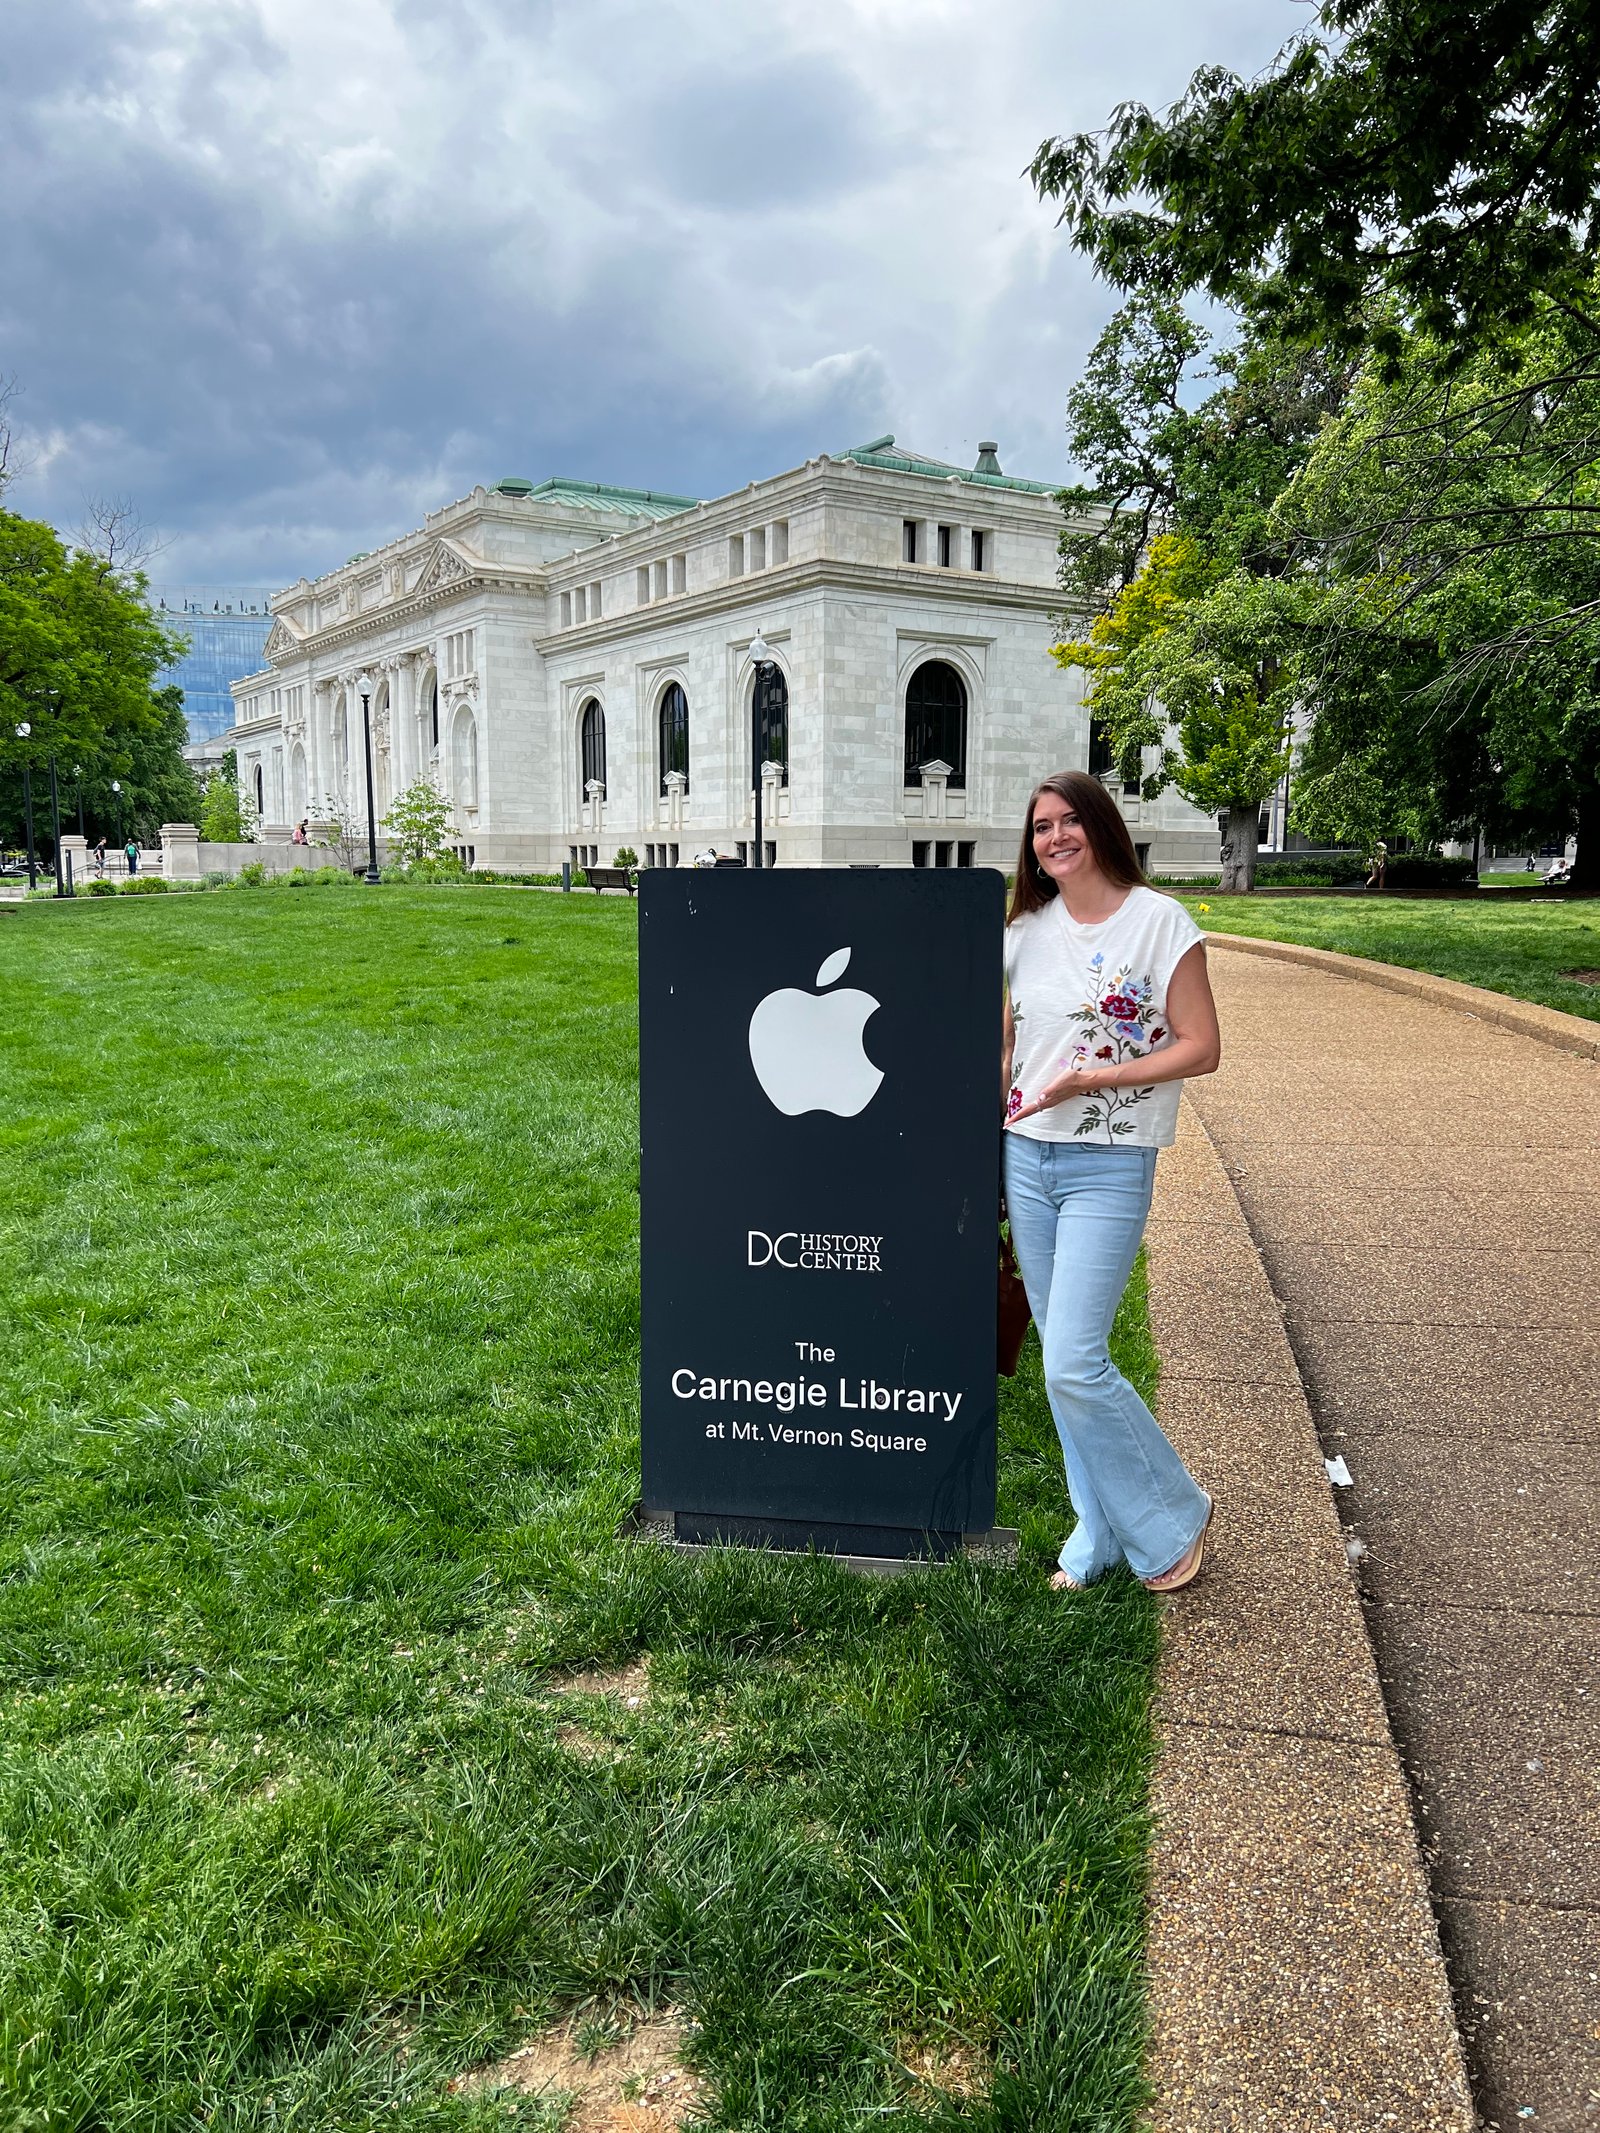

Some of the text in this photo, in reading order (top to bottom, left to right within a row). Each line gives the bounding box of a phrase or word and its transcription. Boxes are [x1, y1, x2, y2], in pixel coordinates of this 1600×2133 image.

[747, 1230, 884, 1268] DC HISTORY
[799, 1251, 883, 1272] CENTER
[794, 1341, 836, 1363] The
[671, 1368, 963, 1422] Carnegie Library
[705, 1421, 927, 1453] at Mt. Vernon Square
